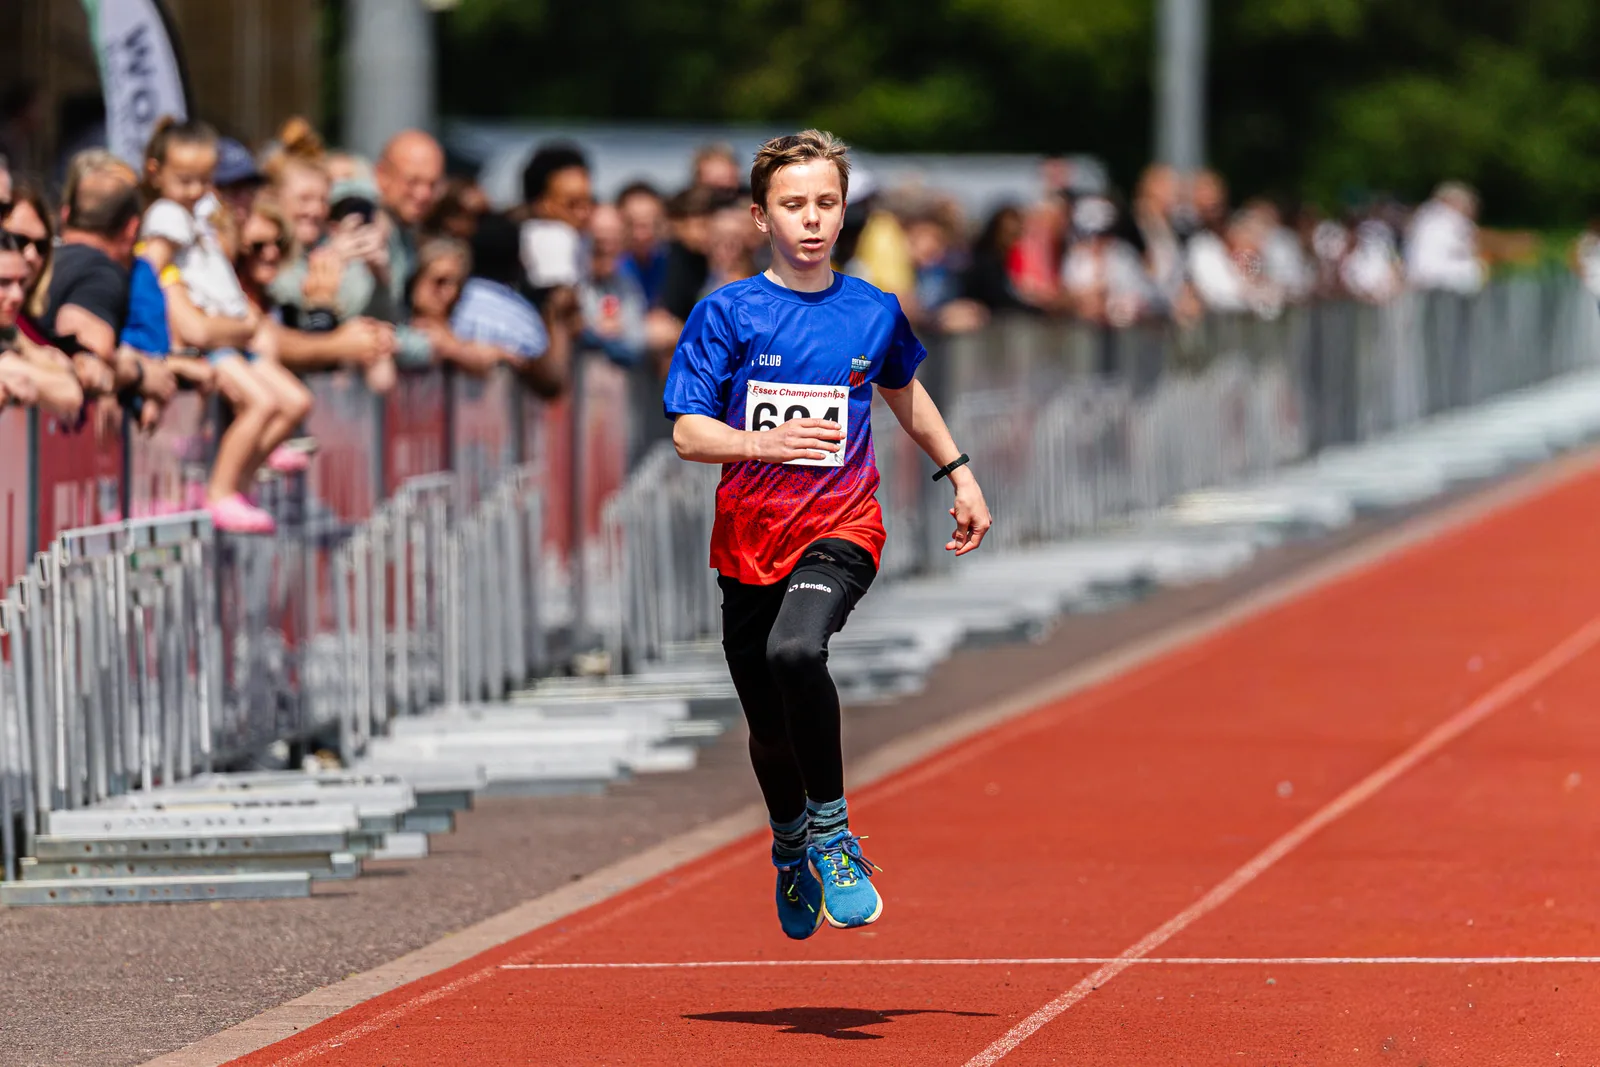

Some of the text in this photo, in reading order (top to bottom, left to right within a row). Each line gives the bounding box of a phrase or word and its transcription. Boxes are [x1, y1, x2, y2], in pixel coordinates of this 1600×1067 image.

[759, 353, 782, 367] CLUB
[752, 385, 846, 400] Essex Championships
